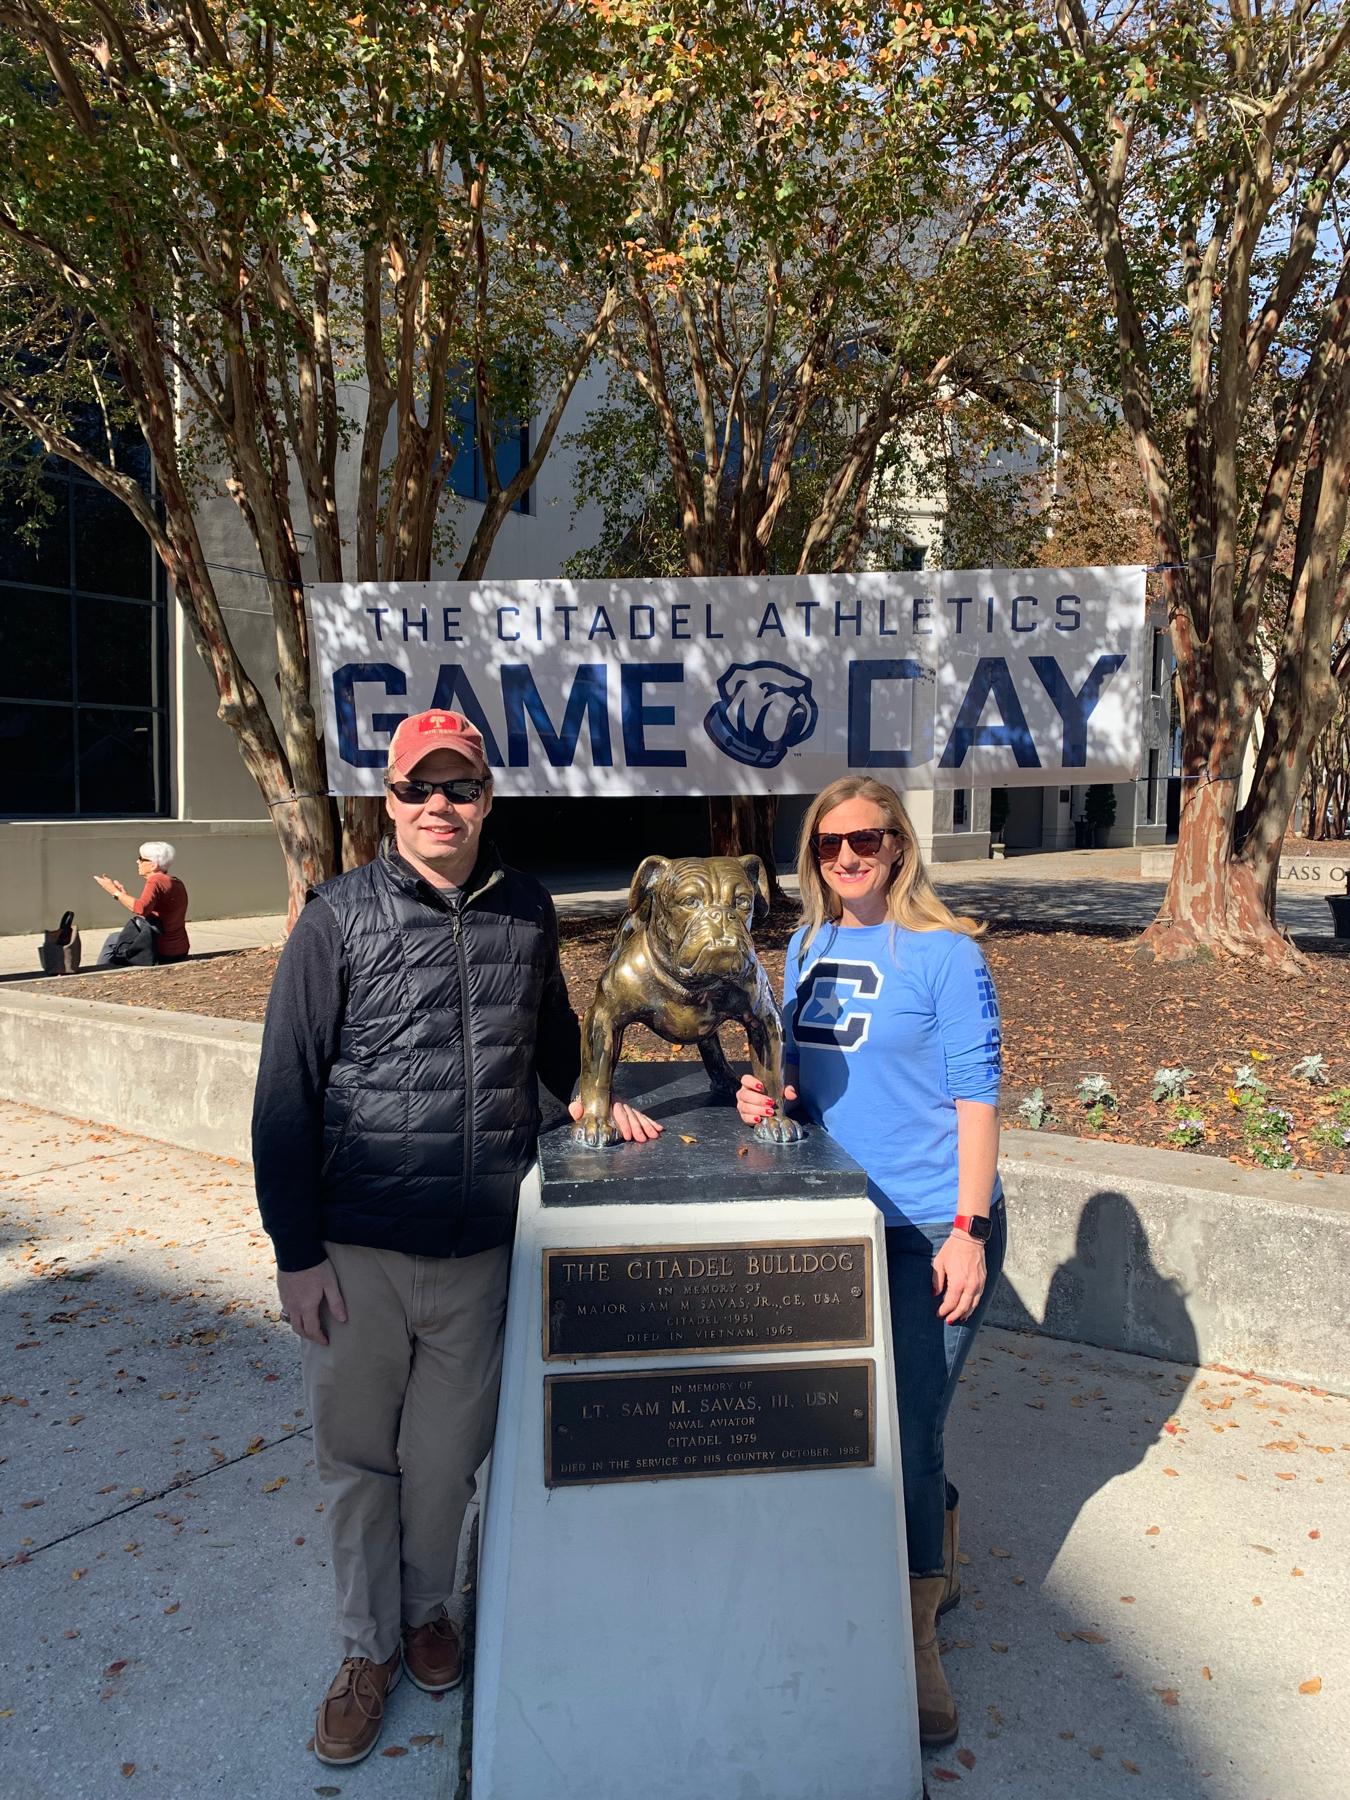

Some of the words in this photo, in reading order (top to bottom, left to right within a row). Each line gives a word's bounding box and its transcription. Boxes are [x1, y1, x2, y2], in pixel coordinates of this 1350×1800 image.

[367, 607, 463, 641] THE
[497, 604, 724, 641] CITADEL
[757, 594, 1081, 637] ATHLETICS
[332, 662, 687, 768] GAME
[847, 654, 1128, 769] DAY
[1277, 866, 1320, 880] LASS
[562, 1263, 610, 1281] THE
[627, 1257, 733, 1280] CITADEL
[747, 1253, 853, 1275] BULLDOG
[658, 1287, 673, 1295] IN
[684, 1284, 738, 1295] MEMORY
[745, 1283, 761, 1293] OF
[577, 1303, 628, 1315] MAJOR
[640, 1302, 669, 1312] SAM
[814, 1293, 841, 1304] USA
[666, 1314, 719, 1326] CITADEL
[627, 1333, 659, 1343] DIED
[670, 1332, 683, 1341] IN
[671, 1385, 682, 1393] IN
[688, 1382, 732, 1393] MEMORY
[739, 1381, 753, 1390] OF
[582, 1405, 609, 1419] LT.
[622, 1402, 659, 1416] SAM
[671, 1400, 691, 1414] M.
[700, 1396, 761, 1412] SAVAS,
[805, 1391, 839, 1406] USN
[668, 1420, 704, 1430] NAVAL
[710, 1417, 755, 1427] AVIATOR
[667, 1435, 721, 1448] CITADEL
[731, 1433, 757, 1444] 1979
[561, 1463, 586, 1473] DIED
[592, 1462, 603, 1471] IN
[609, 1460, 631, 1469] THE
[636, 1456, 678, 1468] SERVICE
[684, 1456, 697, 1465] OF
[703, 1455, 721, 1464] HIS
[726, 1451, 775, 1462] COUNTRY
[839, 1446, 860, 1455] 1985
